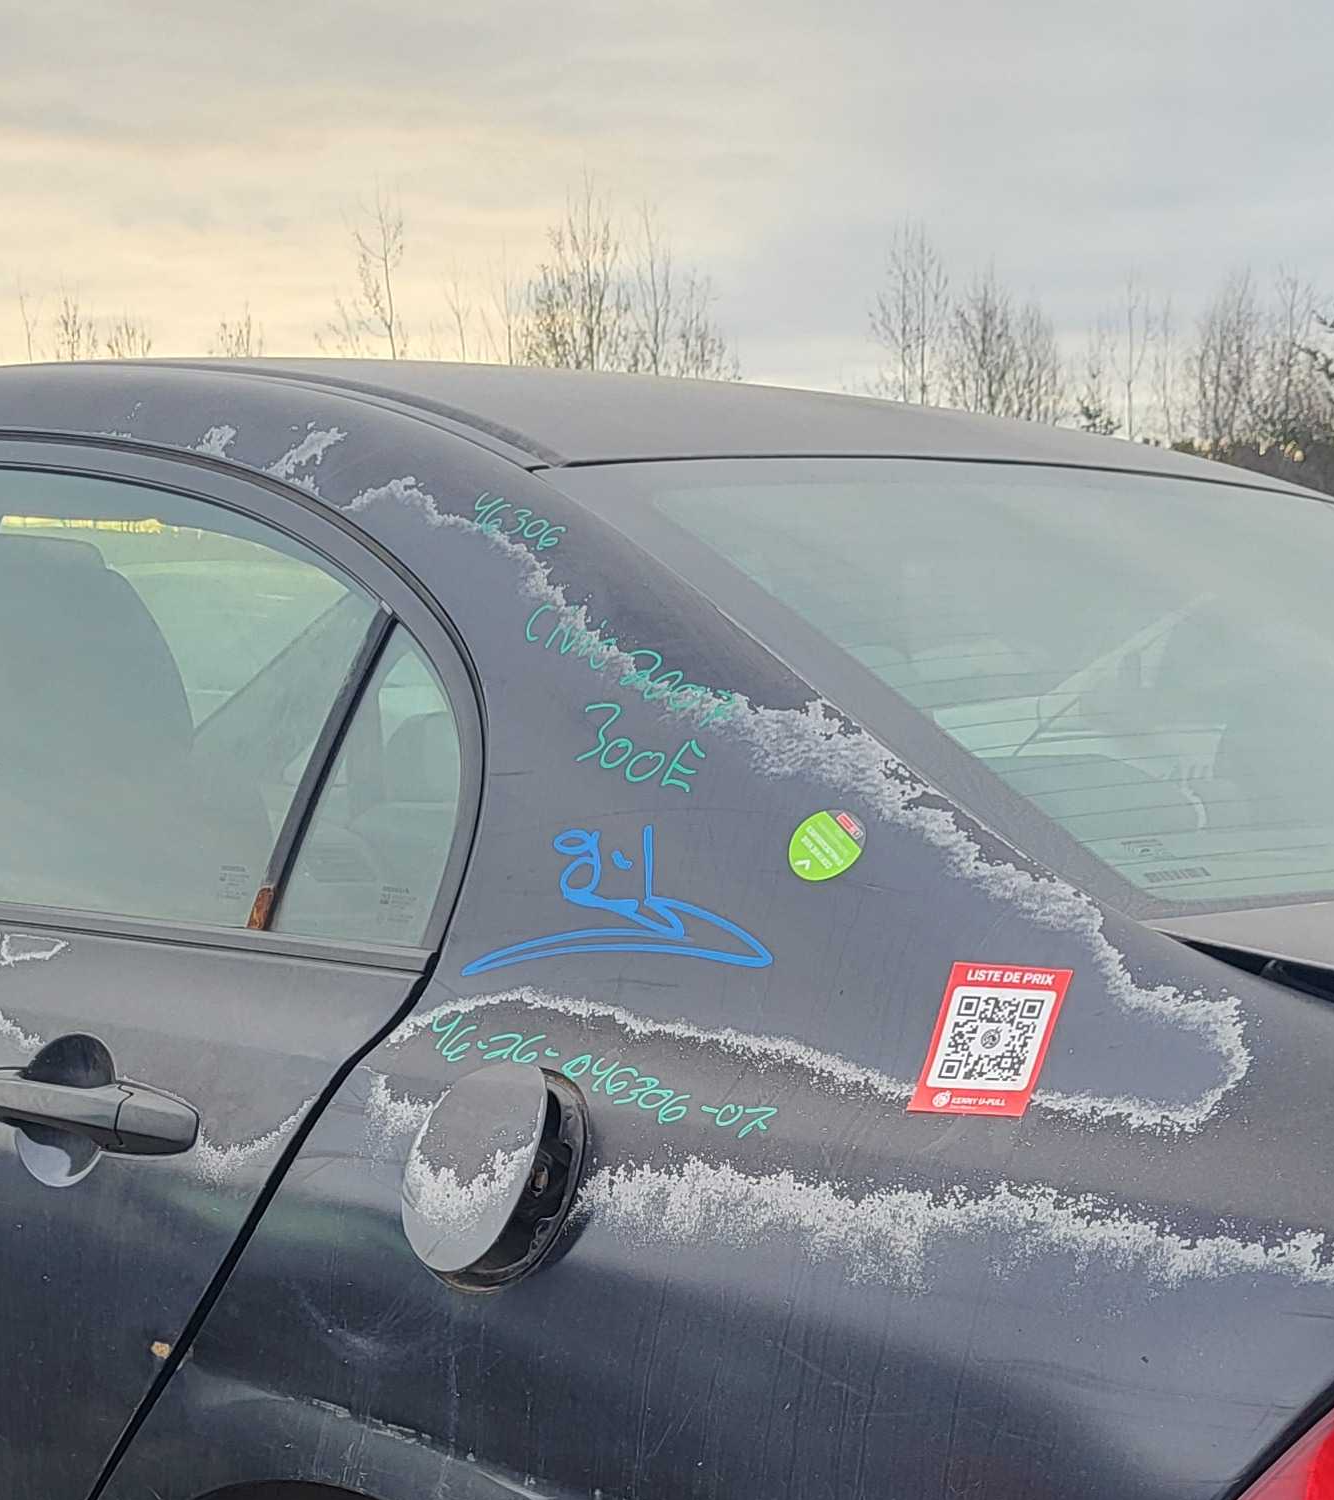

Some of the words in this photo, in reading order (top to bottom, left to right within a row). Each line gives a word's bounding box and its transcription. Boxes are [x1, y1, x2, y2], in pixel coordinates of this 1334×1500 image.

[474, 492, 566, 550] 46306
[575, 703, 706, 792] 300E
[967, 969, 1002, 982] LISTE
[1003, 971, 1021, 983] DE
[1023, 973, 1056, 986] PRIX
